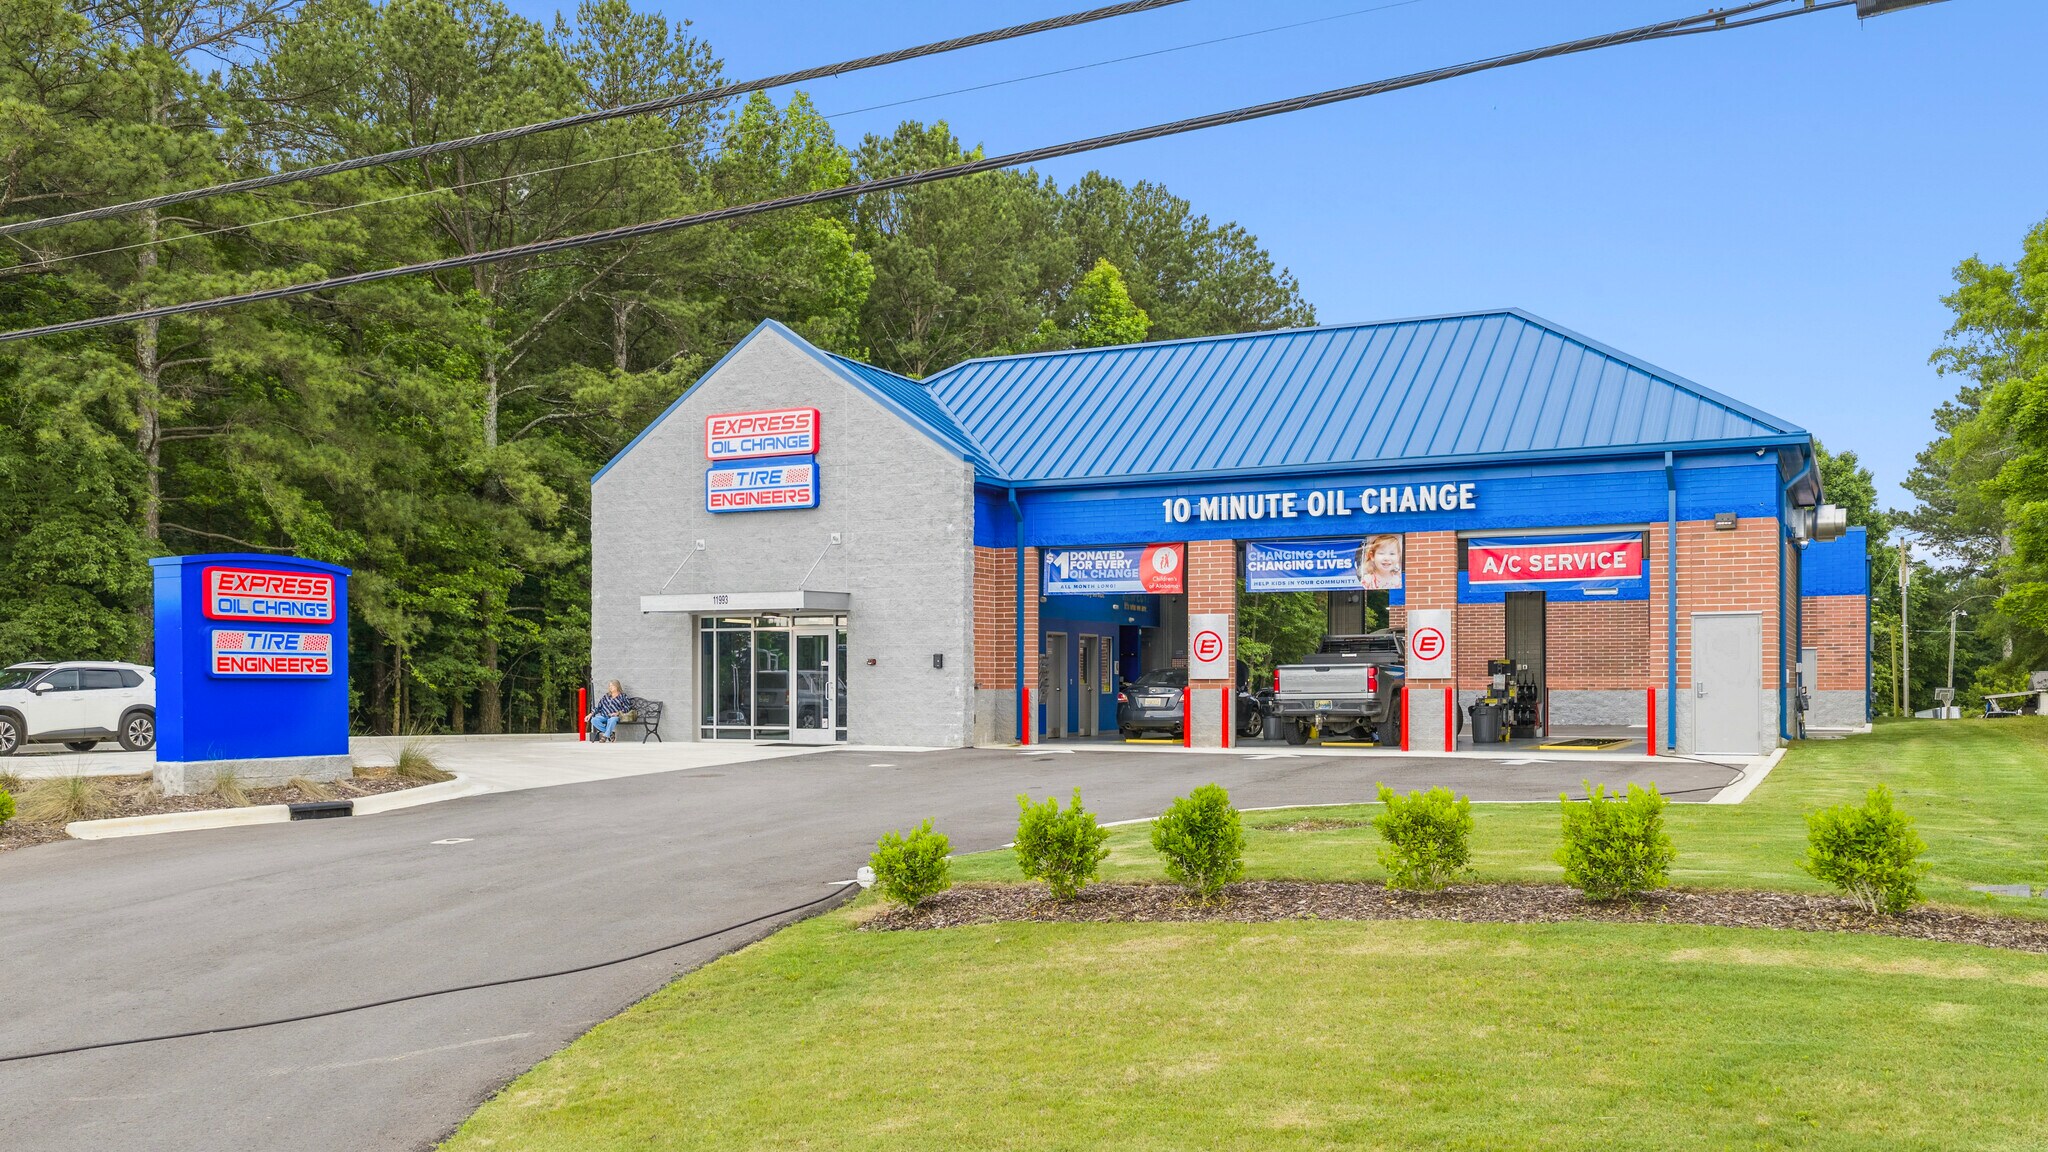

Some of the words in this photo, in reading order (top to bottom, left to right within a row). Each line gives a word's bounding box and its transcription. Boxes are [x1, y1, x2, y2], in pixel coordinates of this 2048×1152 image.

[712, 414, 810, 435] EXPRESS
[712, 440, 737, 454] OIL
[740, 435, 810, 452] CHANGE
[737, 470, 783, 486] TIRE
[711, 488, 810, 507] ENGINEERS
[1162, 498, 1191, 523] 10
[1199, 493, 1298, 521] MINUTE
[1307, 490, 1352, 517] OIL
[1358, 483, 1476, 515] CHANGE
[1070, 551, 1125, 560] DONATED
[1248, 550, 1314, 561] CHANGING
[1316, 550, 1337, 559] OIL
[1482, 553, 1522, 575] A/C
[1529, 551, 1627, 572] SERVICE
[1070, 561, 1093, 570] FOR
[1095, 559, 1132, 570] EVERY
[1248, 559, 1314, 571] CHANGING
[1317, 559, 1352, 570] LIVES
[1069, 570, 1088, 579] OIL
[1090, 569, 1138, 579] CHANGE
[217, 573, 328, 596] EXPRESS
[218, 598, 249, 613] OIL
[252, 600, 328, 617] CHANGE
[713, 595, 728, 604] 11993
[247, 633, 300, 650] TIRE
[217, 656, 328, 673] ENGINEERS
